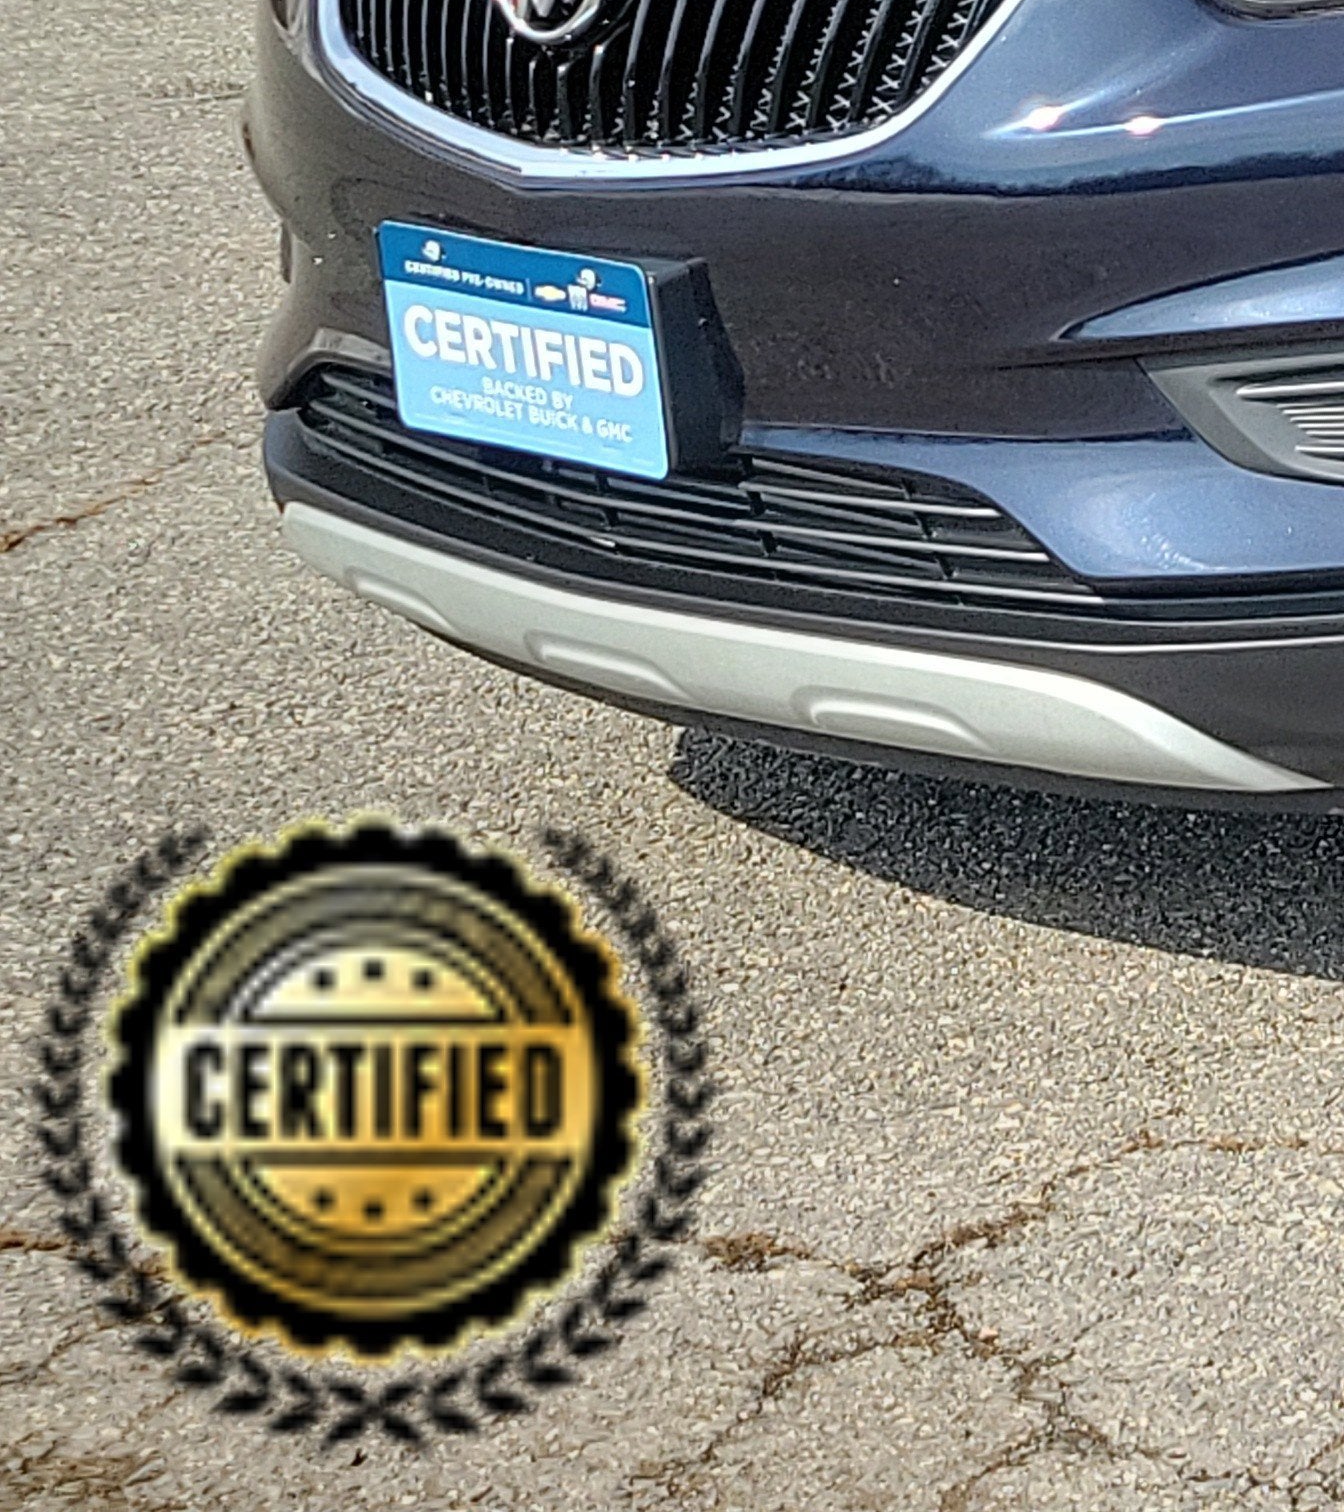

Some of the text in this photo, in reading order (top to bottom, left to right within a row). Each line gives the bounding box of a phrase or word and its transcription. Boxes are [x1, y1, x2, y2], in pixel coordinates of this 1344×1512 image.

[404, 305, 645, 397] CERTIFIED
[430, 386, 524, 422] CHEVROLET
[528, 405, 580, 432] BUICK
[581, 416, 594, 435] &
[596, 419, 634, 444] GMC
[482, 376, 574, 410] BACKED BY
